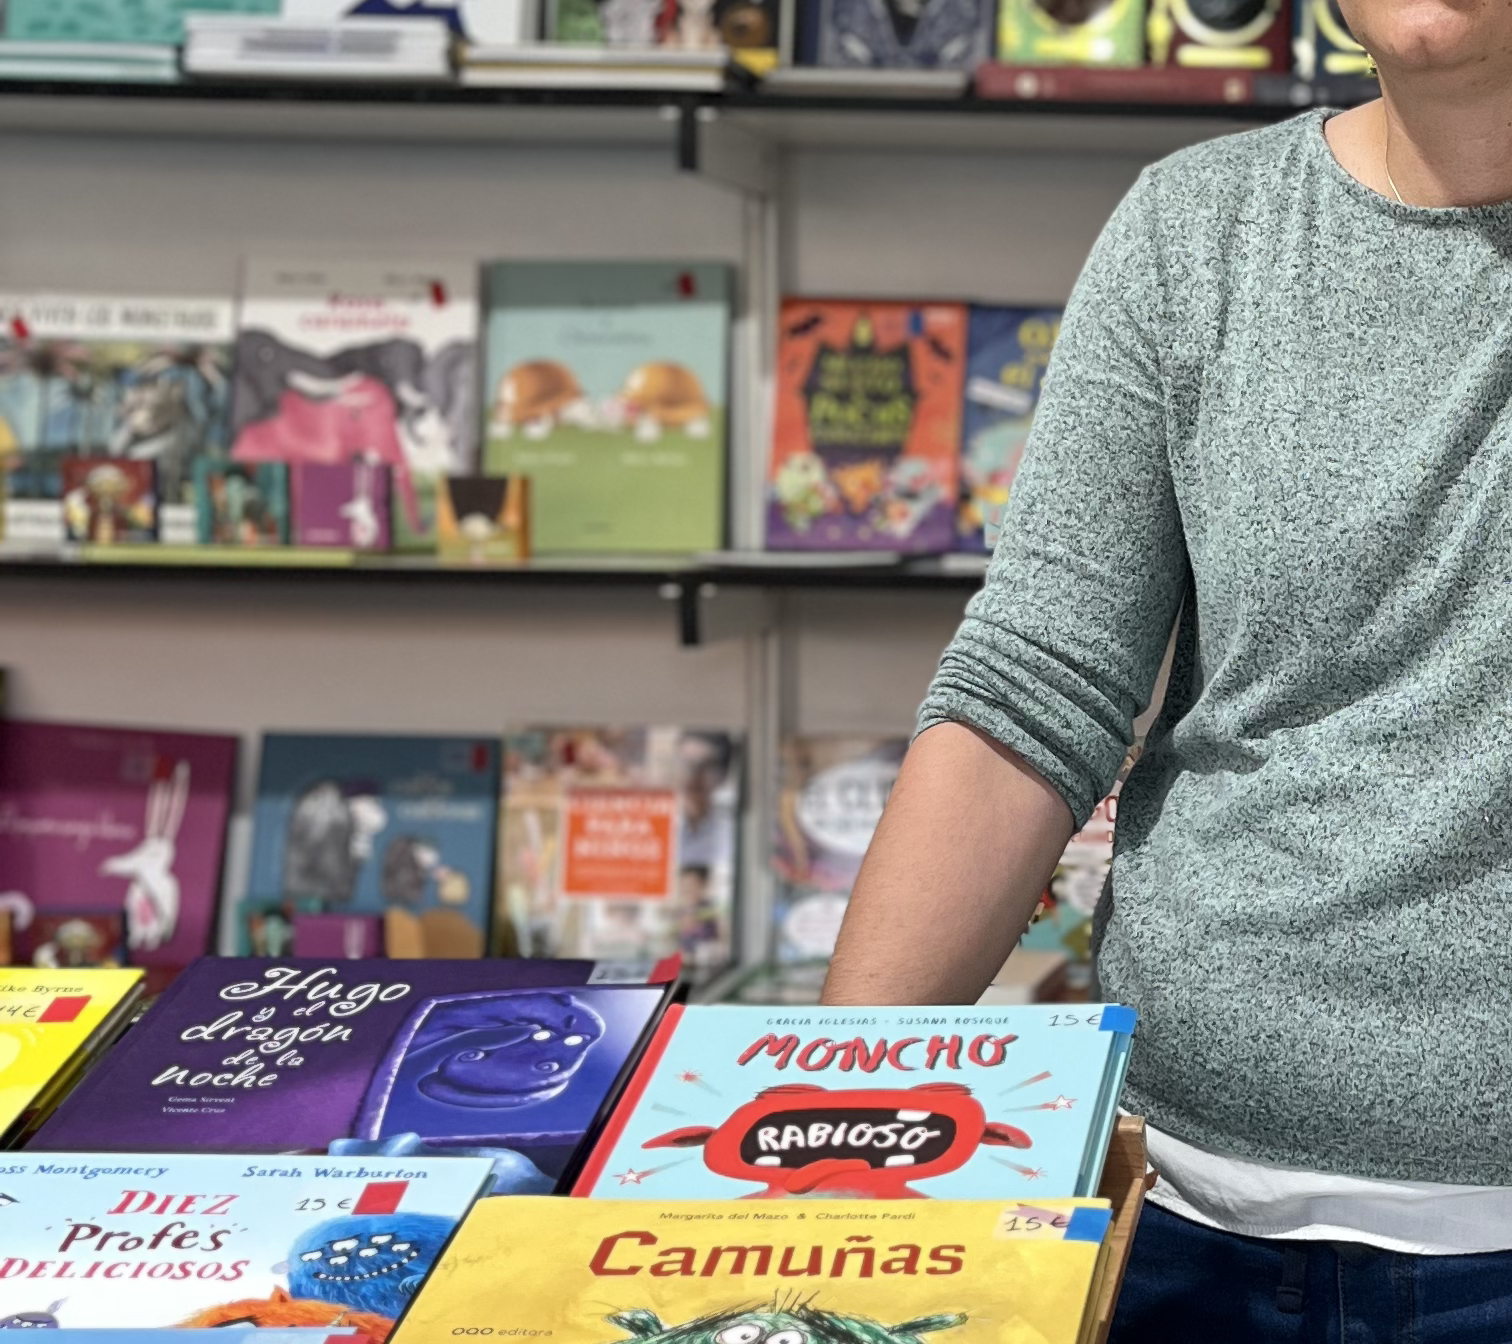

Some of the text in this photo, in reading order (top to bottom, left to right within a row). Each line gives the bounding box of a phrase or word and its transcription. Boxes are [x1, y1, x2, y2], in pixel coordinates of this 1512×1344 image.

[31, 985, 84, 995] Byrne
[219, 967, 411, 1016] Hugo
[252, 1000, 325, 1022] y el
[766, 1017, 812, 1027] GRACIA
[818, 1016, 878, 1026] IGLESIAS
[897, 1016, 948, 1026] SUSANA
[954, 1016, 1010, 1026] ROSIQUE
[1049, 1013, 1081, 1027] 15
[181, 1011, 352, 1053] dragón
[222, 1049, 304, 1066] de la
[736, 1032, 1019, 1073] MONCHO
[757, 1120, 941, 1152] RABIOSO
[32, 1164, 170, 1180] Montgomery
[242, 1164, 428, 1180] Sarah Warburton
[106, 1189, 240, 1215] DIEZ
[294, 1198, 328, 1211] 15
[658, 1212, 725, 1222] Margarita
[728, 1212, 750, 1220] del
[752, 1212, 789, 1220] Mazo
[815, 1211, 877, 1221] Charlotte
[881, 1211, 916, 1221] Pardi
[1004, 1216, 1046, 1232] 15
[57, 1221, 235, 1253] Profes
[588, 1229, 967, 1278] Camuñas
[0, 1257, 251, 1282] DELICIOSOS
[498, 1327, 553, 1337] editora
